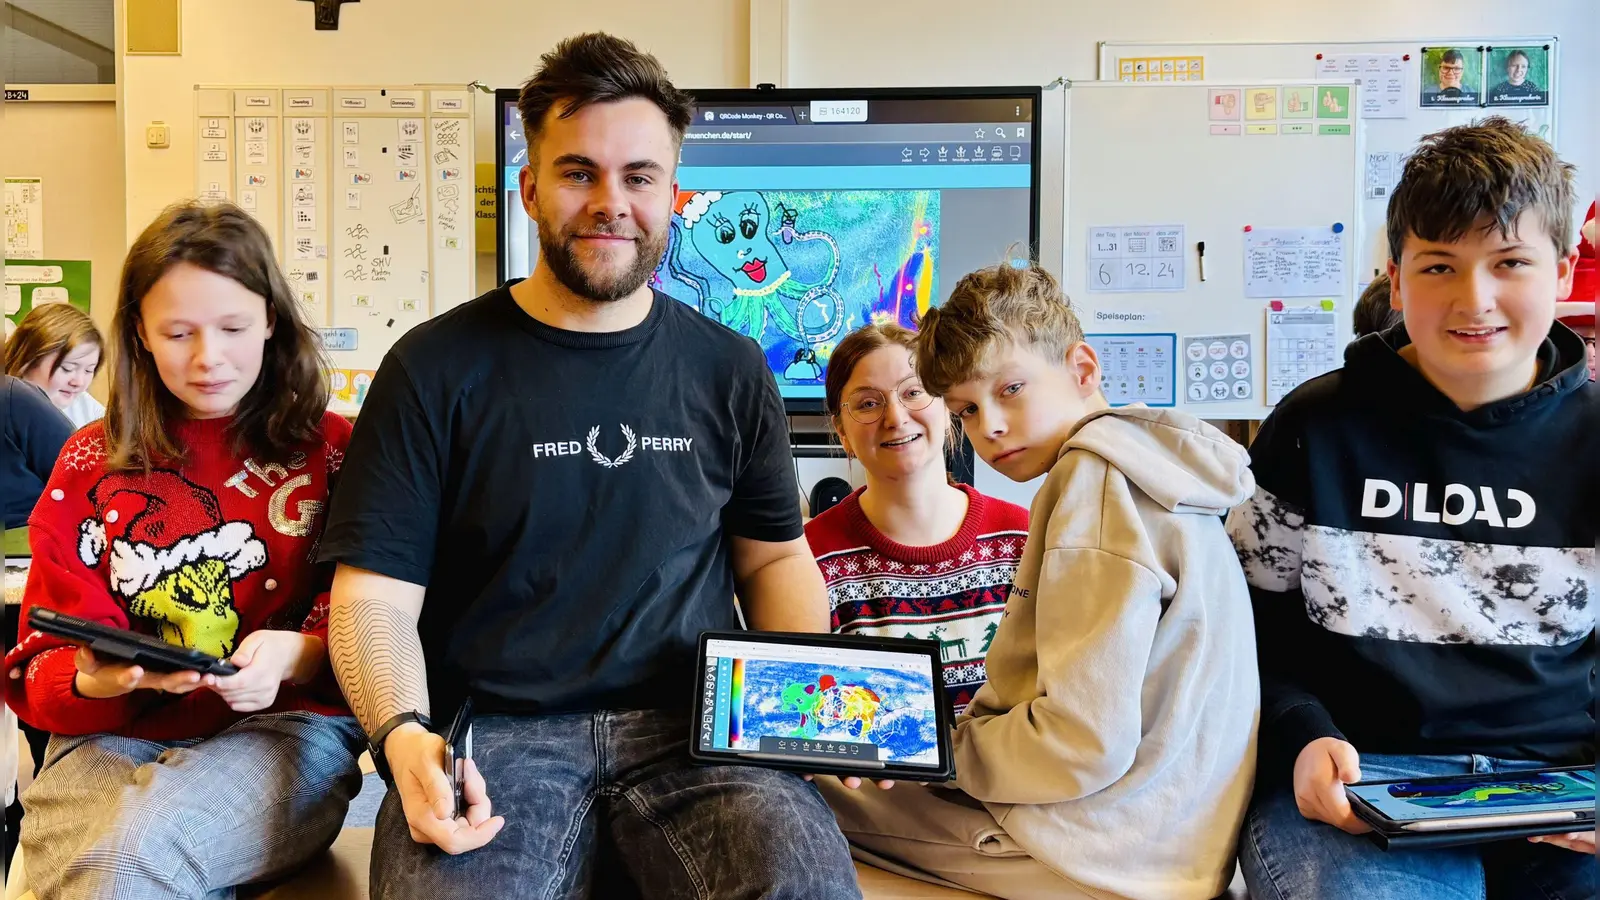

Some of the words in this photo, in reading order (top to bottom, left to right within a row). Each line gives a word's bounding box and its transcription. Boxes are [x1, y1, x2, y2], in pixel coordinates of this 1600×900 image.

[831, 107, 861, 115] 164120
[475, 186, 497, 195] ichti
[480, 198, 495, 206] der
[1098, 243, 1117, 251] 1...31
[1099, 263, 1111, 285] 6
[1125, 263, 1150, 275] 12.
[1157, 262, 1175, 278] 24
[1096, 311, 1145, 321] Speiseplan:
[323, 330, 337, 339] geht
[325, 340, 346, 348] heute?
[533, 441, 582, 458] FRED
[641, 436, 693, 452] PERRY
[223, 451, 308, 498] The
[268, 473, 324, 537] G
